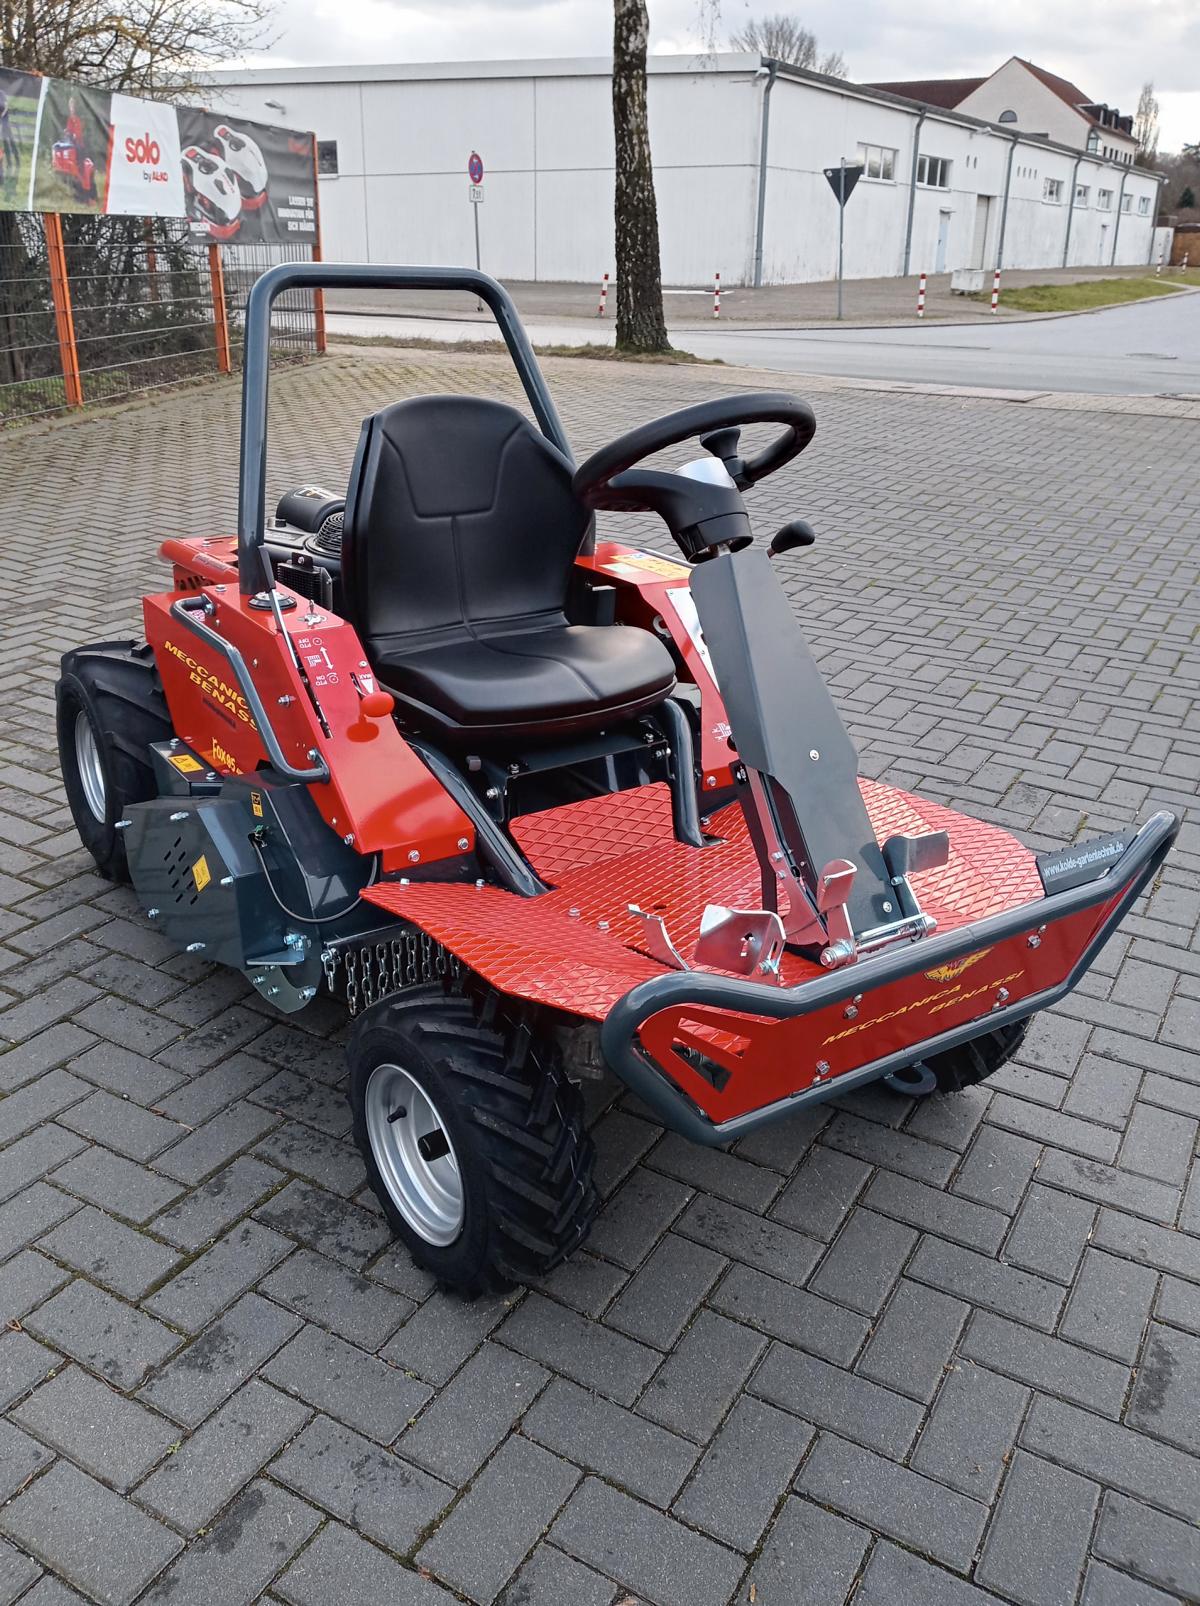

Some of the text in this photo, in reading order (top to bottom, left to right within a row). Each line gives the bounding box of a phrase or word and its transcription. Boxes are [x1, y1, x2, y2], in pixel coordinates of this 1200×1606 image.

[125, 132, 160, 165] solo
[163, 640, 249, 710] MECCANIC
[1043, 841, 1124, 877] www.kolde-gartentechnik.de
[822, 984, 962, 1046] MECCANICA
[928, 970, 1025, 1015] BENASSI
